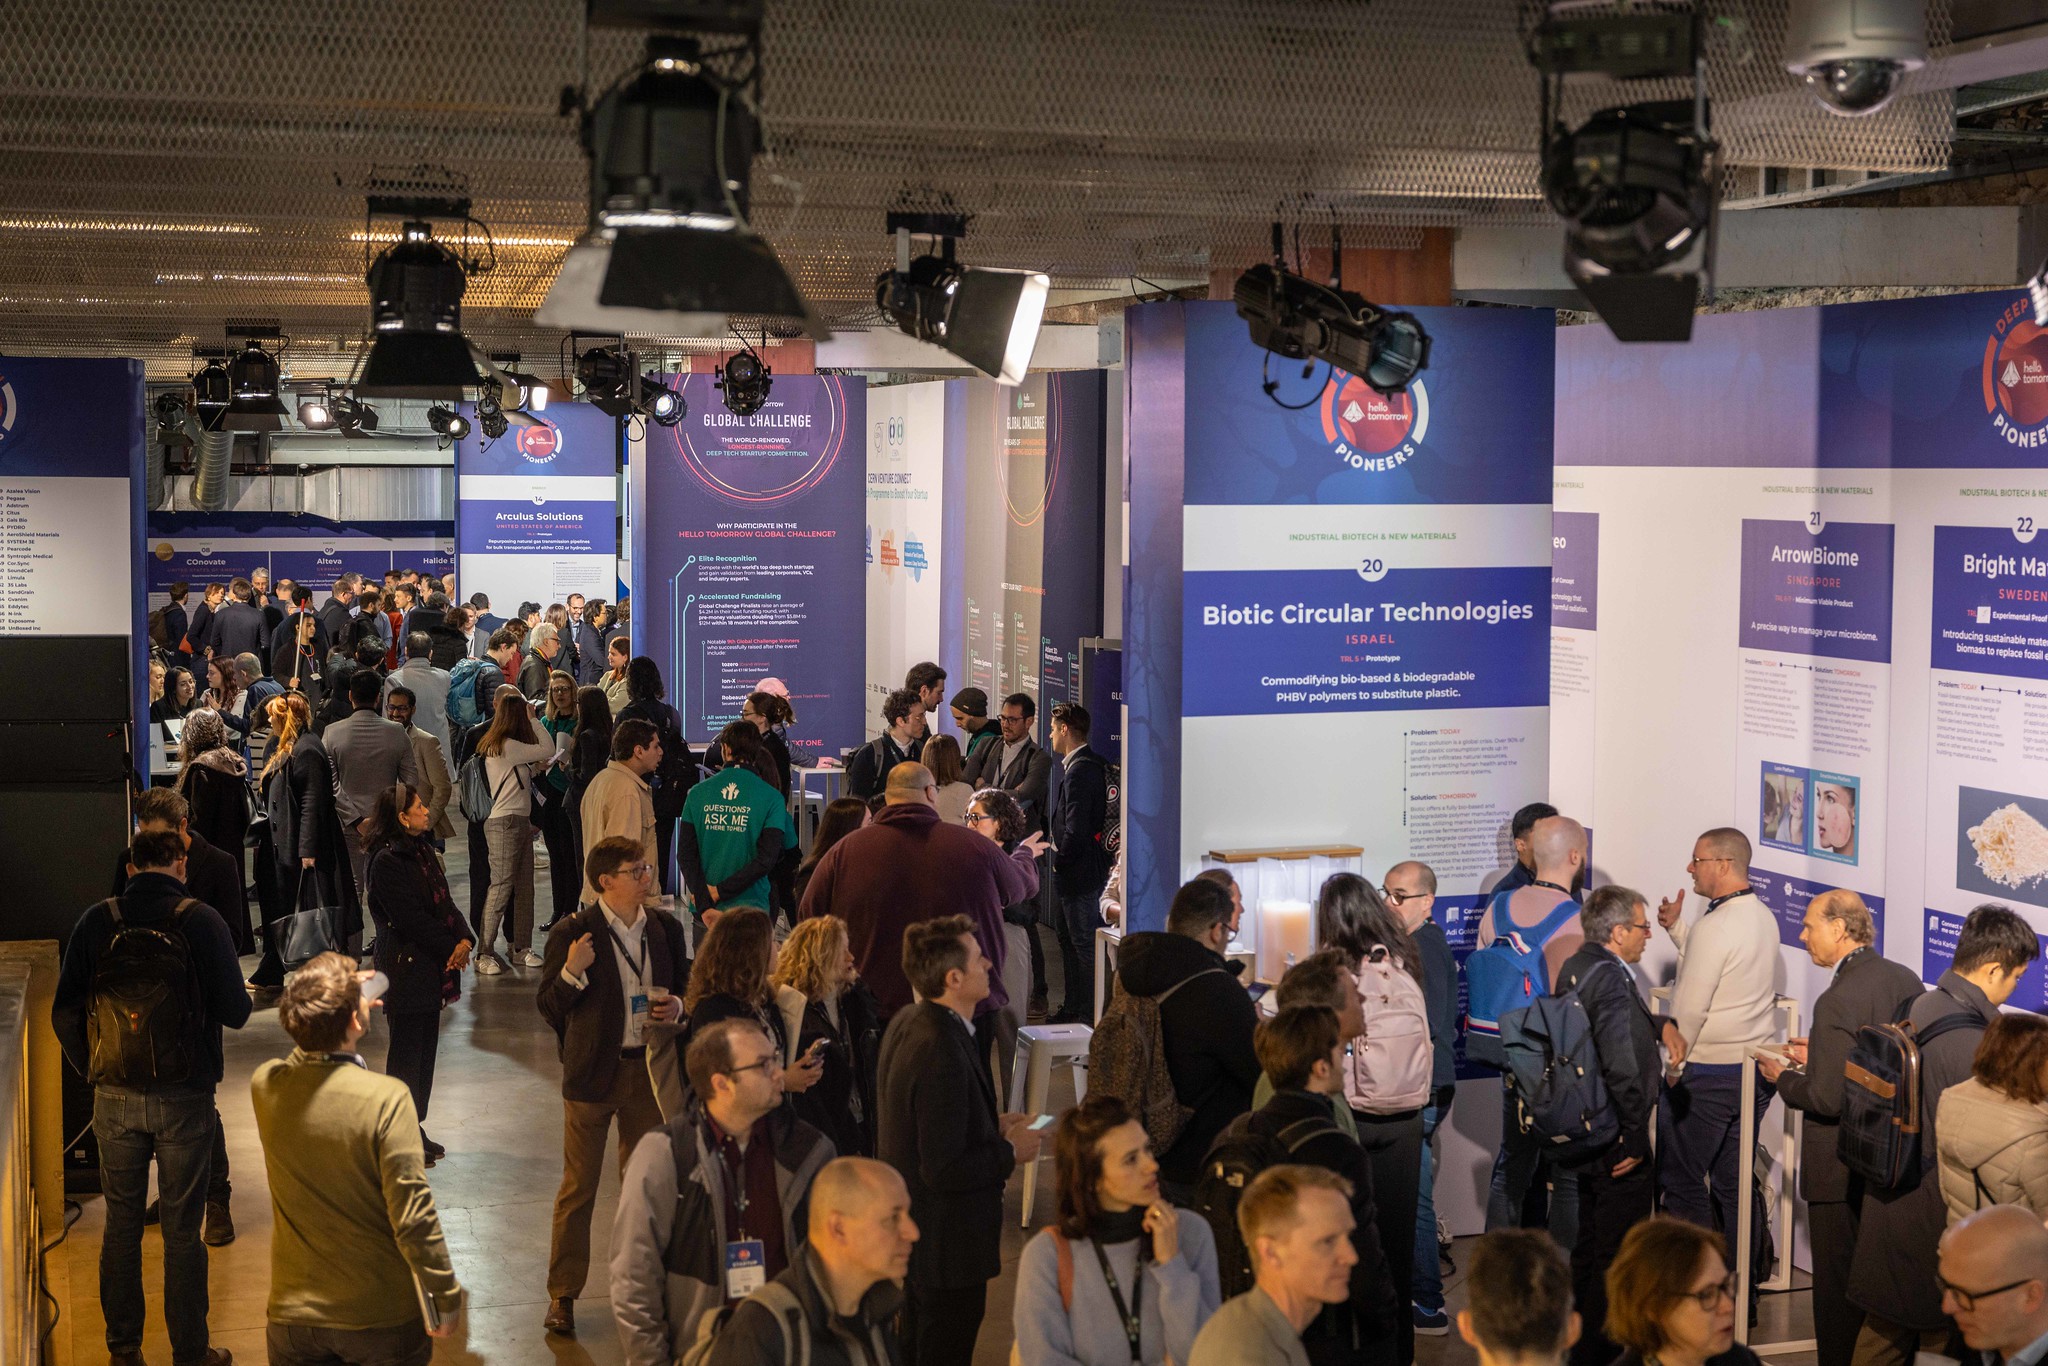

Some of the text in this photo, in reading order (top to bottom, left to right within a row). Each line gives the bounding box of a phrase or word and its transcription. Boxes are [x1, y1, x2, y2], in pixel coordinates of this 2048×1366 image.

[1995, 298, 2029, 335] DEEP
[2023, 361, 2042, 373] hello
[1367, 401, 1388, 412] hello
[703, 413, 812, 428] GLOBAL CHALLENGE
[1006, 415, 1045, 430] GLOBAL CHALLENGE
[1367, 412, 1408, 421] tomorrow
[1993, 412, 2048, 448] PIONEE
[522, 452, 557, 464] PIONEERS
[1334, 442, 1415, 472] PIONEERS
[868, 473, 912, 484] CERN VENTURE CONNECT
[1762, 486, 1794, 494] INDUSTRIAL
[1795, 486, 1820, 494] BIOTECH
[1840, 487, 1873, 495] MATERIALS
[1959, 488, 2037, 497] INDUSTRIAL BIOTECH &
[495, 512, 584, 521] Arculus Solutions
[1810, 512, 1821, 526] 21
[2017, 517, 2033, 533] 22
[1289, 533, 1340, 541] INDUSTRIAL
[1341, 533, 1378, 541] BIOTECH
[1410, 532, 1457, 540] MATERIALS
[715, 555, 757, 563] Recognition
[1771, 545, 1859, 567] ArrowBiome
[1362, 558, 1383, 573] 20
[1963, 553, 2016, 579] Bright
[1787, 575, 1841, 588] SINGAPORE
[1999, 588, 2048, 602] SWEDEN
[1795, 597, 1854, 608] Minimum Viable Product
[1202, 599, 1534, 626] Biotic Circular Technologies
[1992, 611, 2048, 623] Experimental Proof
[1751, 622, 1878, 642] A precise way to manage your microbiome.
[1942, 628, 2027, 647] Introducing sustainable
[1346, 634, 1395, 645] ISRAEL
[1340, 654, 1401, 664] TRL Prototype
[1956, 643, 2043, 661] biomass to replace fossil
[1261, 670, 1475, 688] Commodifying bio-based & biodegradable
[1276, 686, 1462, 704] PHBV polymers to substitute plastic.
[1938, 680, 2047, 699] Problem: TODAY Solution:
[703, 804, 751, 814] QUESTIONS?
[704, 813, 749, 827] ASK ME
